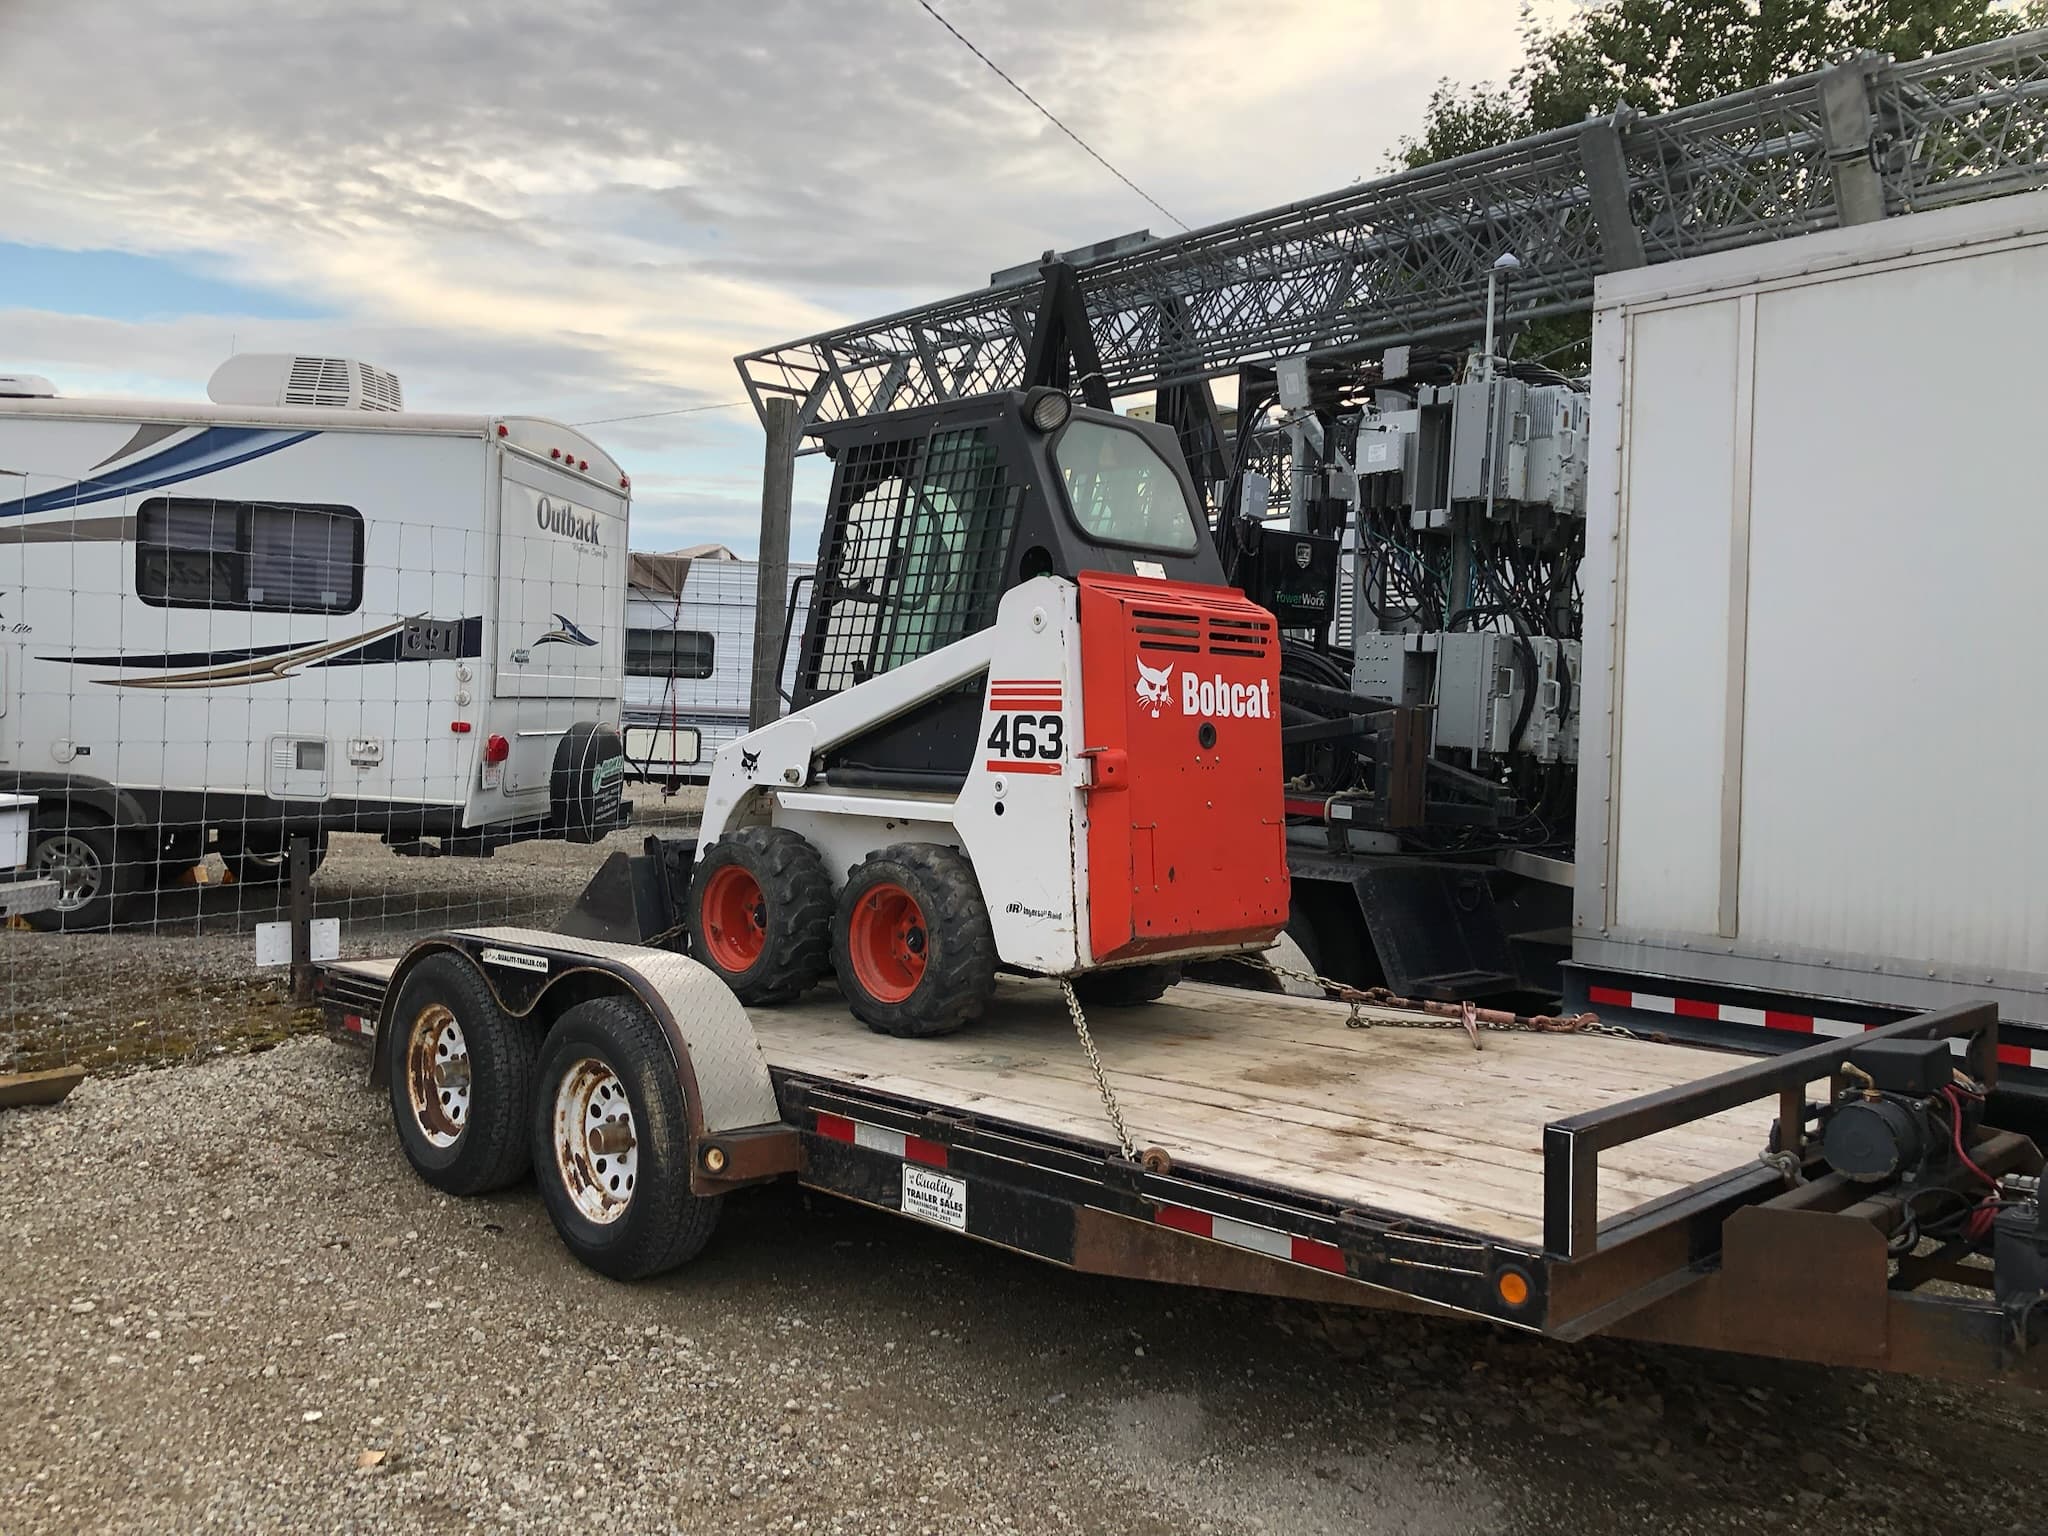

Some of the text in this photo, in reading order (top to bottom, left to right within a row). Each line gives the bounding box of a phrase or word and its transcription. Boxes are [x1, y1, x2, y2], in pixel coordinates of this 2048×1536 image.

[537, 497, 599, 545] Outback
[1275, 591, 1325, 607] TowerWorx
[1182, 672, 1270, 719] Bobcat
[987, 714, 1063, 759] 463
[907, 1188, 963, 1212] TRAILER SALES
[915, 1173, 954, 1199] Quality
